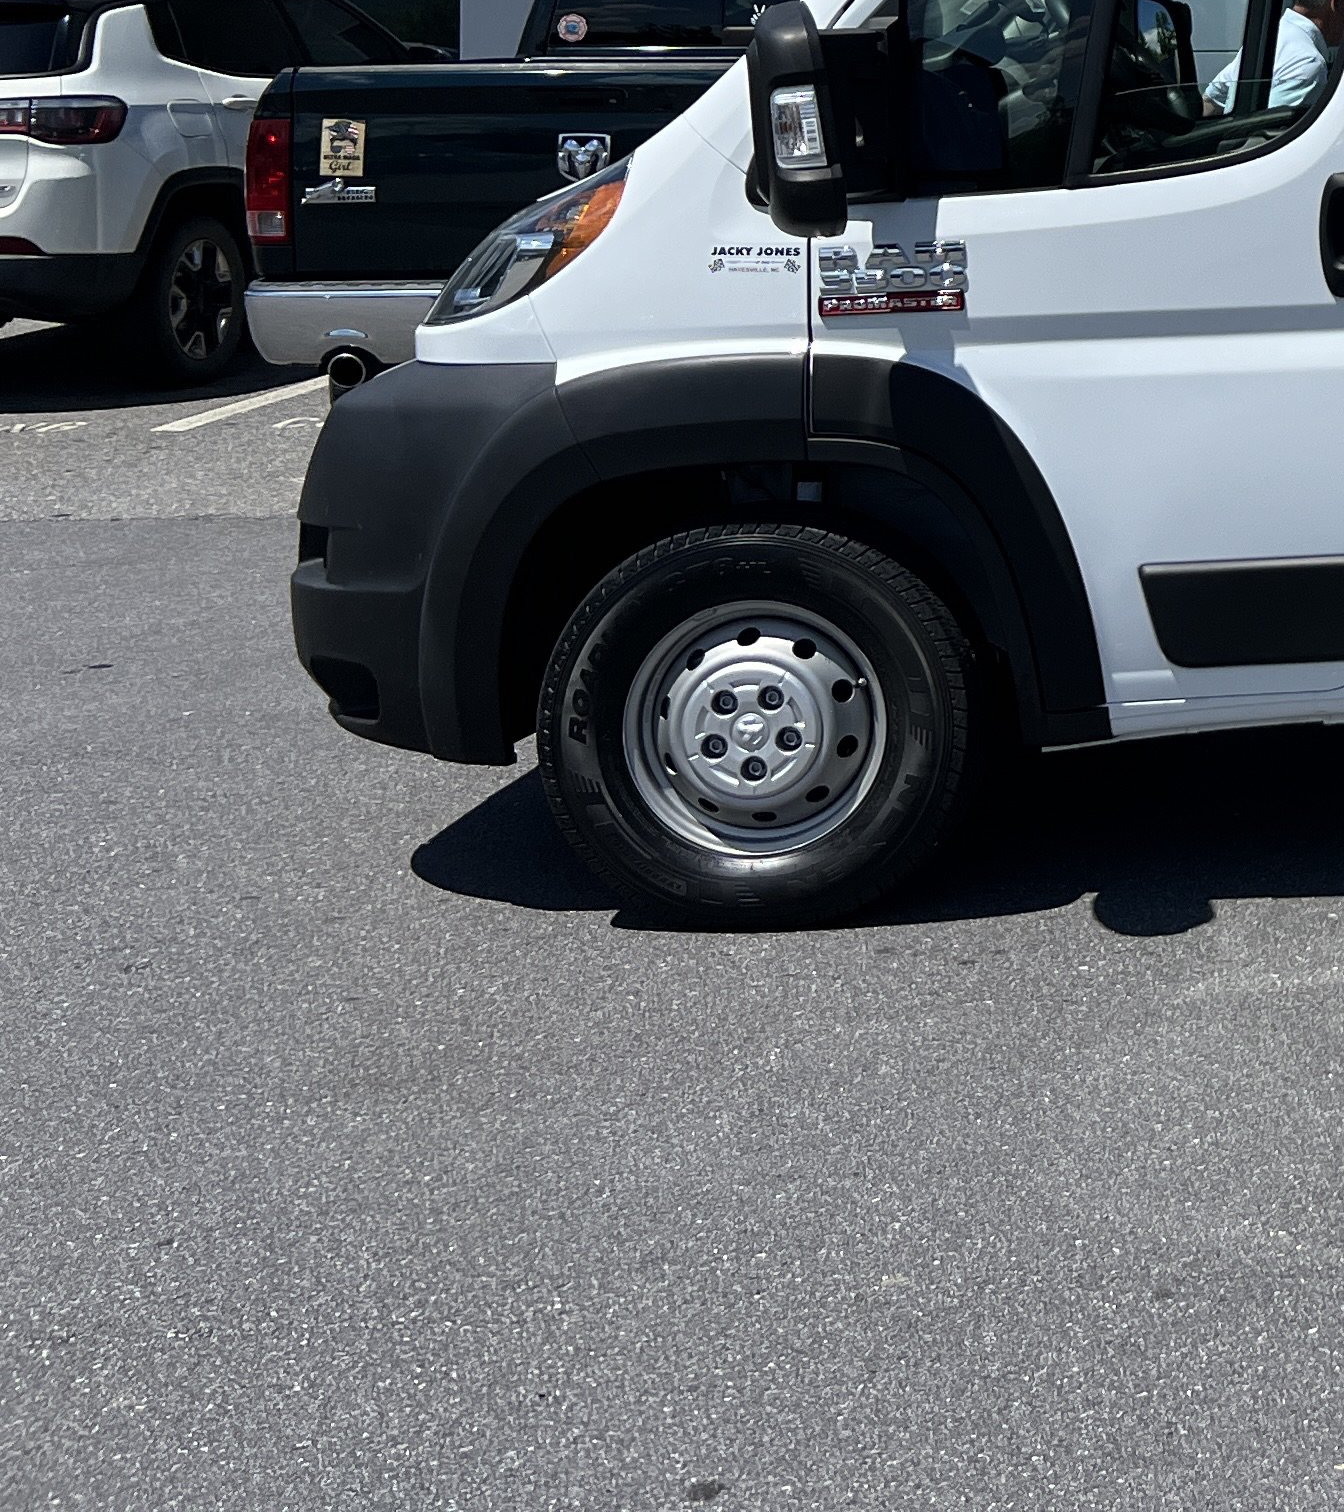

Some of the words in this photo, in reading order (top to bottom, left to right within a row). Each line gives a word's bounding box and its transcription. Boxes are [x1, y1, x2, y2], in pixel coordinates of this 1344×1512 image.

[711, 247, 753, 256] JACKY
[756, 247, 801, 256] JONES
[819, 240, 967, 272] RAM
[823, 295, 958, 311] PROMASTER
